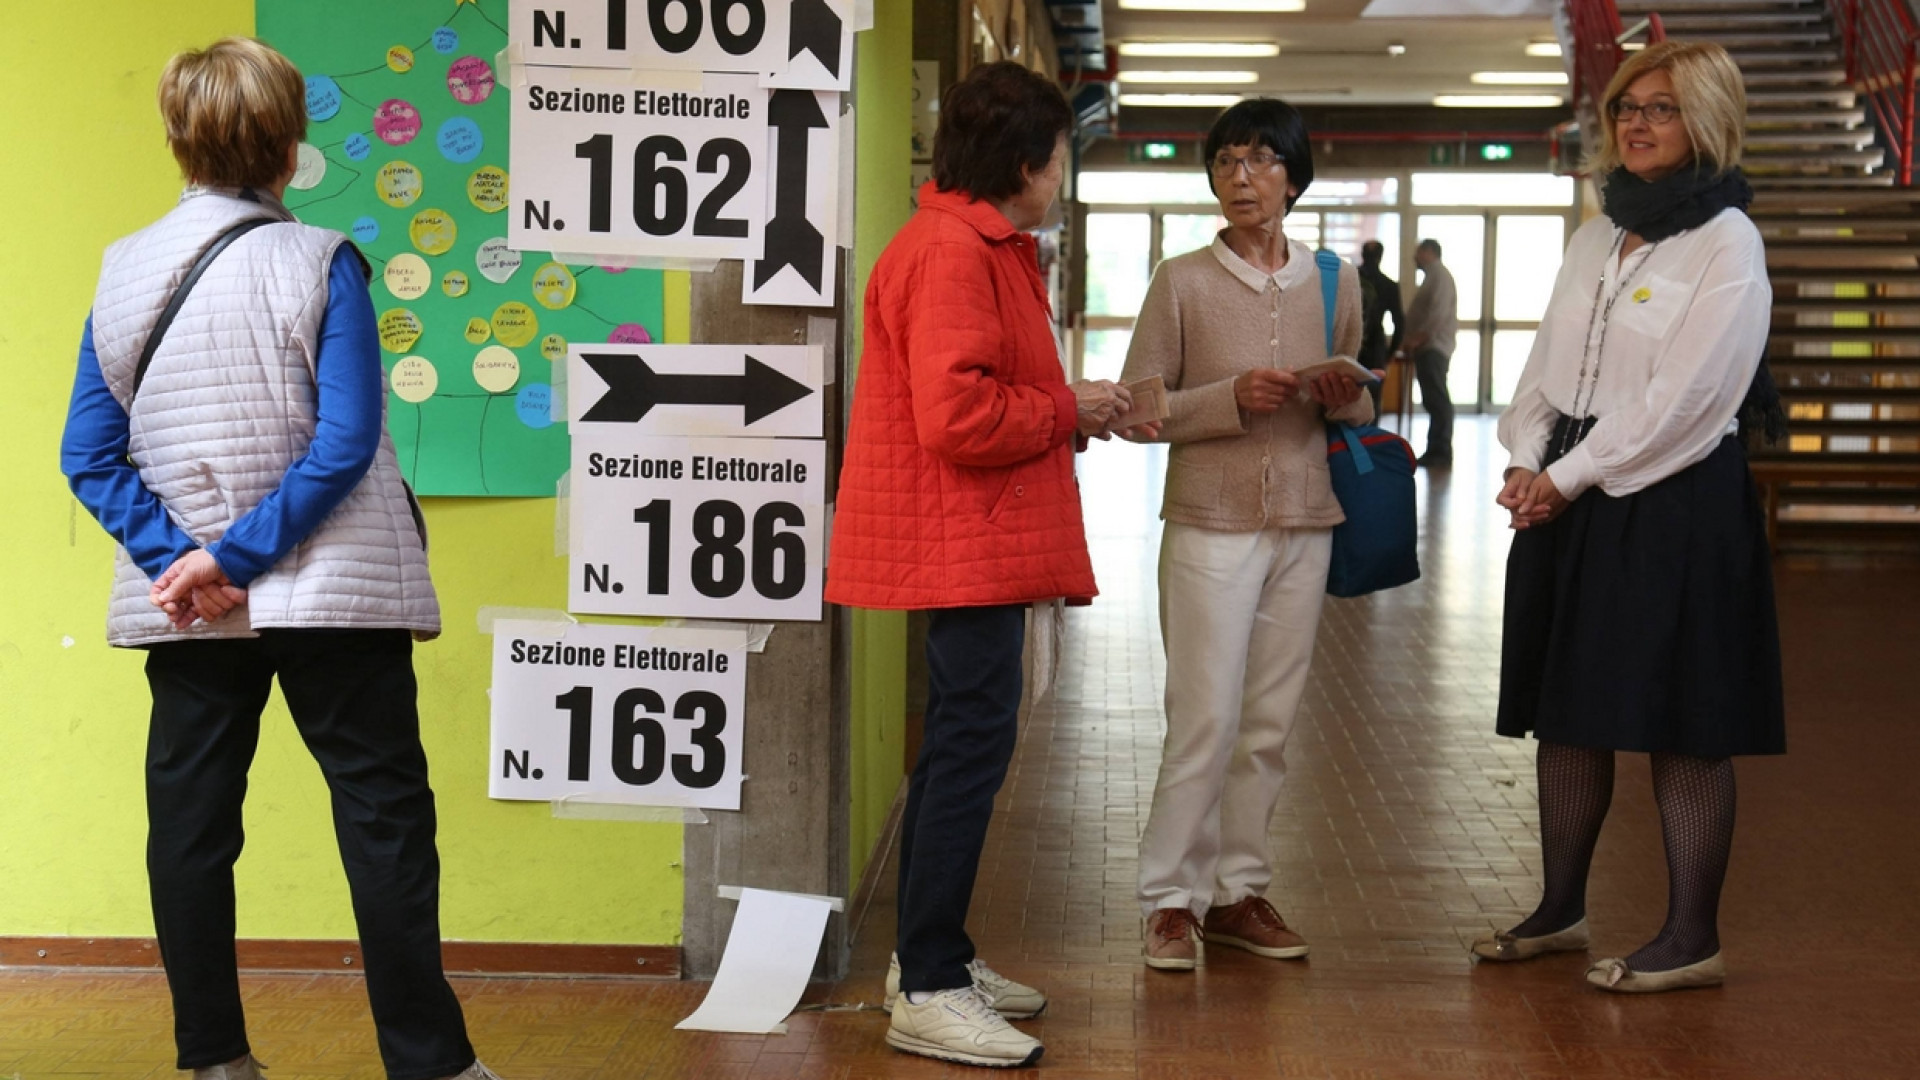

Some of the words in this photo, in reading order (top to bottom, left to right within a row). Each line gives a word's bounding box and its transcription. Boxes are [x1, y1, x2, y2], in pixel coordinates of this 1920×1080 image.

[534, 10, 581, 48] N.
[529, 85, 625, 114] Sezione
[634, 90, 750, 119] Elettorale
[524, 200, 565, 231] N.
[575, 134, 752, 239] 162
[589, 452, 683, 480] Sezione
[692, 456, 807, 483] Elettorale
[583, 563, 624, 594] N.
[634, 498, 806, 600] 186
[510, 639, 605, 668] Sezione
[614, 644, 729, 673] Elettorale
[503, 749, 544, 780] N.
[555, 685, 727, 789] 163
